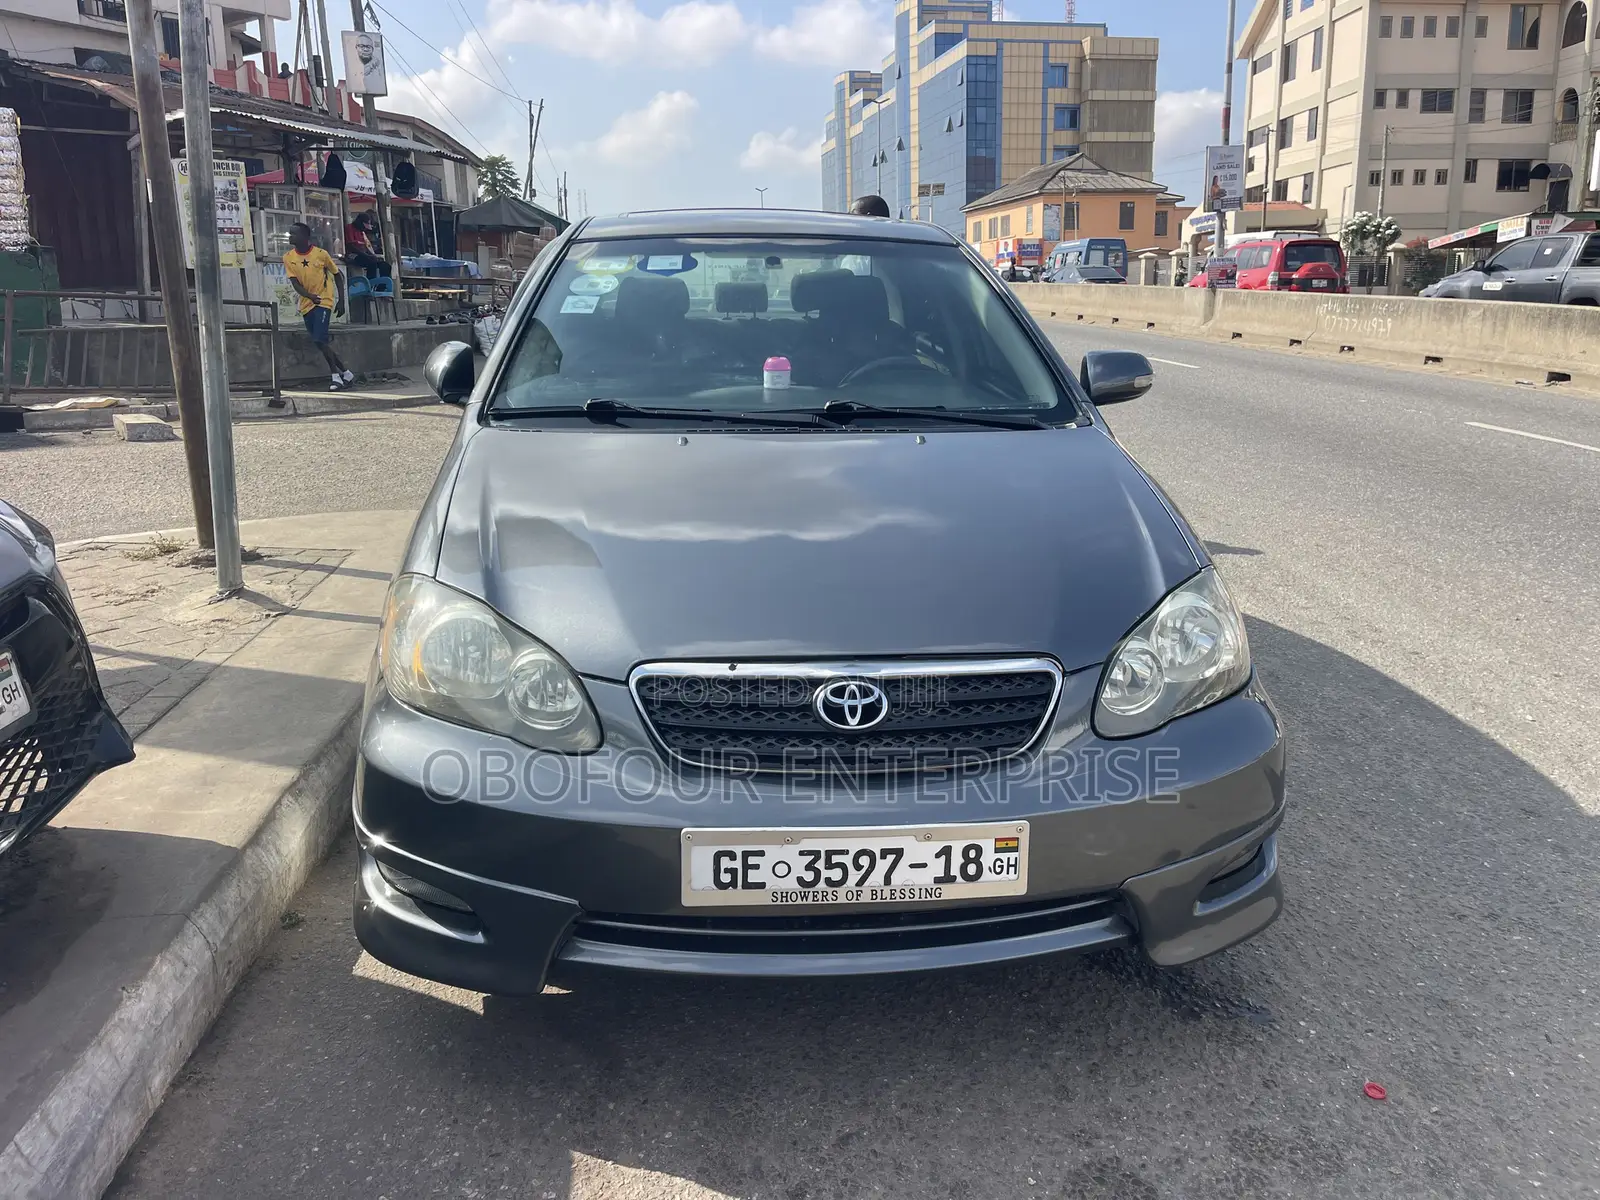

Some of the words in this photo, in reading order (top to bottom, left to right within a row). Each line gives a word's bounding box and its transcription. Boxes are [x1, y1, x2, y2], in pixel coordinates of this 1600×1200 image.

[2, 681, 21, 705] GH
[713, 850, 766, 890] GE
[796, 843, 983, 888] 3597-18
[992, 857, 1018, 875] GH
[771, 890, 838, 903] SHOWERS
[845, 890, 863, 902] OF
[870, 887, 942, 901] BLESSING
